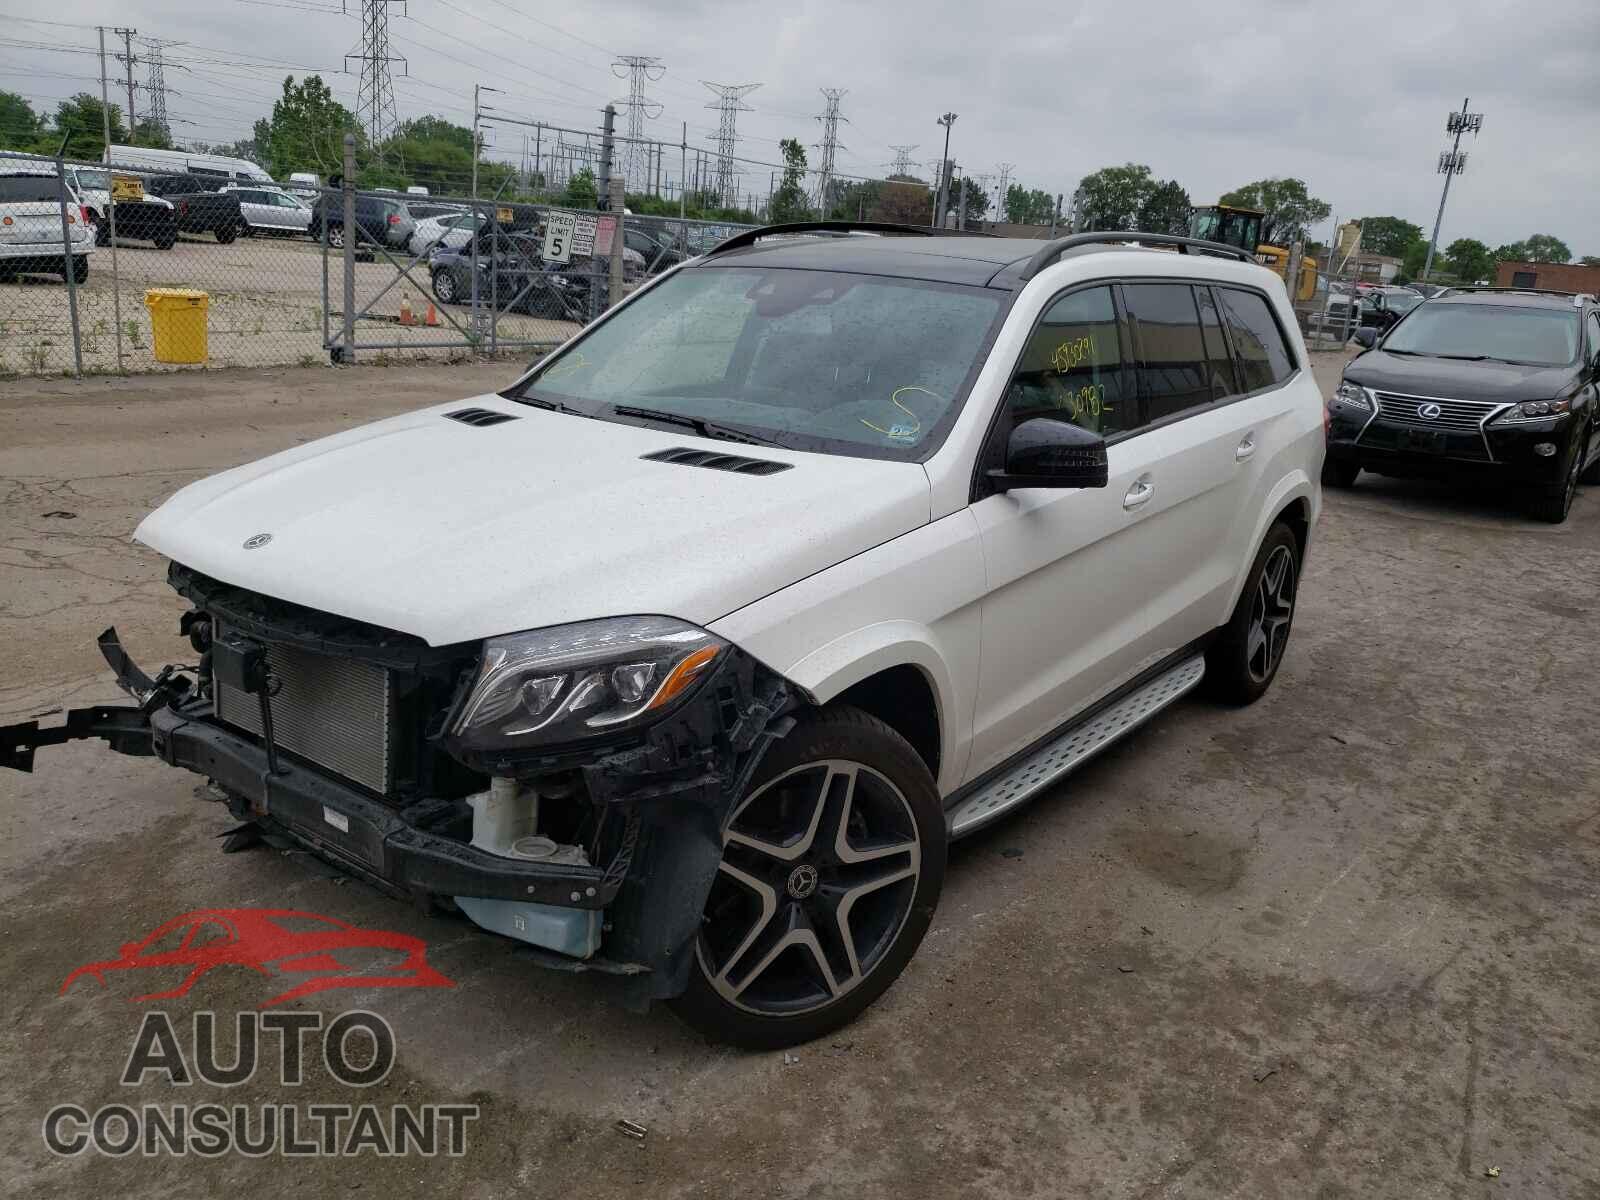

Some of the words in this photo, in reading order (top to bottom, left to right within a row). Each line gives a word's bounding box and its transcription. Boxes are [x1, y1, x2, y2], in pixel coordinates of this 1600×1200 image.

[550, 215, 574, 226] SPEED
[550, 226, 570, 237] LIMIT
[551, 238, 563, 256] 5
